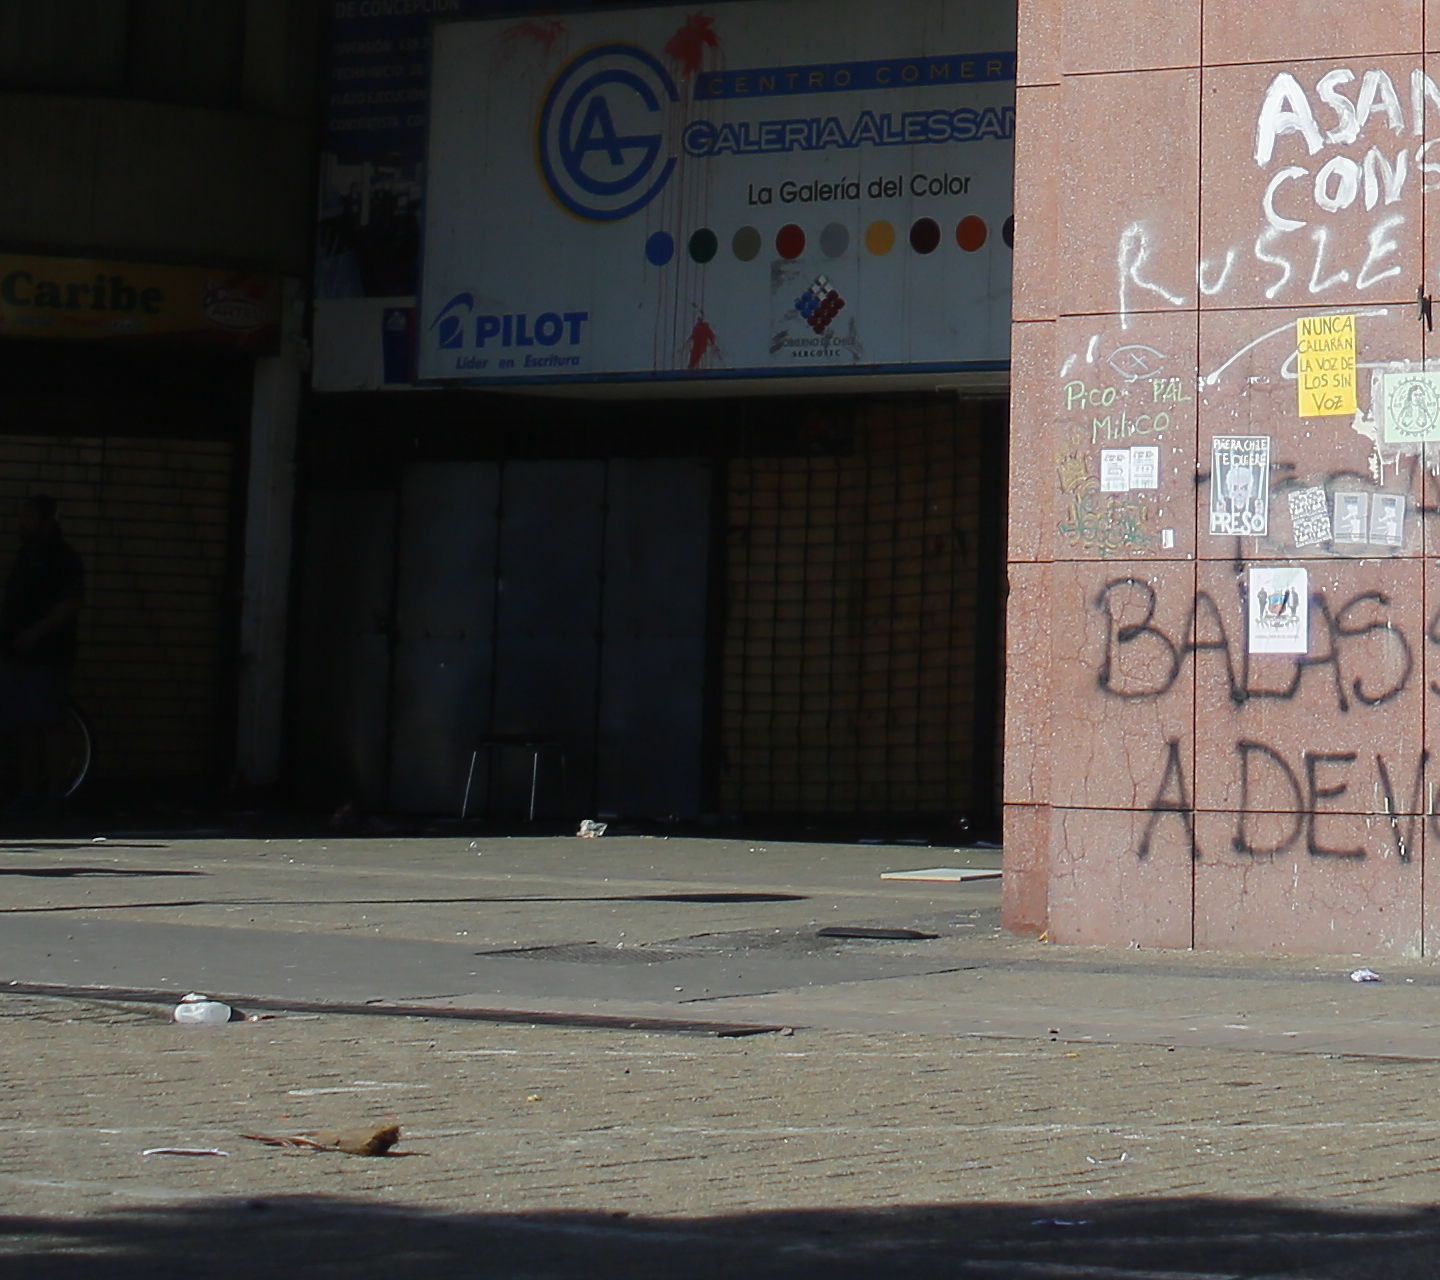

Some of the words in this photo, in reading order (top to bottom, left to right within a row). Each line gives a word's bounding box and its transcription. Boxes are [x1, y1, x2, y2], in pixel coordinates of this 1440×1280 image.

[335, 1, 357, 19] DE
[709, 68, 852, 95] CENTRO
[682, 118, 848, 156] GALERIA
[748, 183, 772, 206] La
[779, 175, 861, 203] Galería
[868, 175, 903, 199] del
[909, 172, 972, 198] Color
[0, 269, 166, 314] Caribe
[475, 311, 589, 348] PILOT
[1302, 316, 1353, 336] NUNCA
[456, 354, 488, 369] Líder
[498, 358, 514, 368] en
[523, 353, 580, 368] Escritura
[1300, 359, 1313, 373] LA
[1316, 357, 1338, 371] VOZ
[1341, 356, 1355, 371] DE
[1304, 373, 1329, 390] LOS
[1333, 373, 1352, 388] SIN
[1215, 452, 1231, 466] TE
[1211, 511, 1266, 535] PRESO
[1094, 575, 1416, 717] BALAS
[1136, 731, 1202, 864] A
